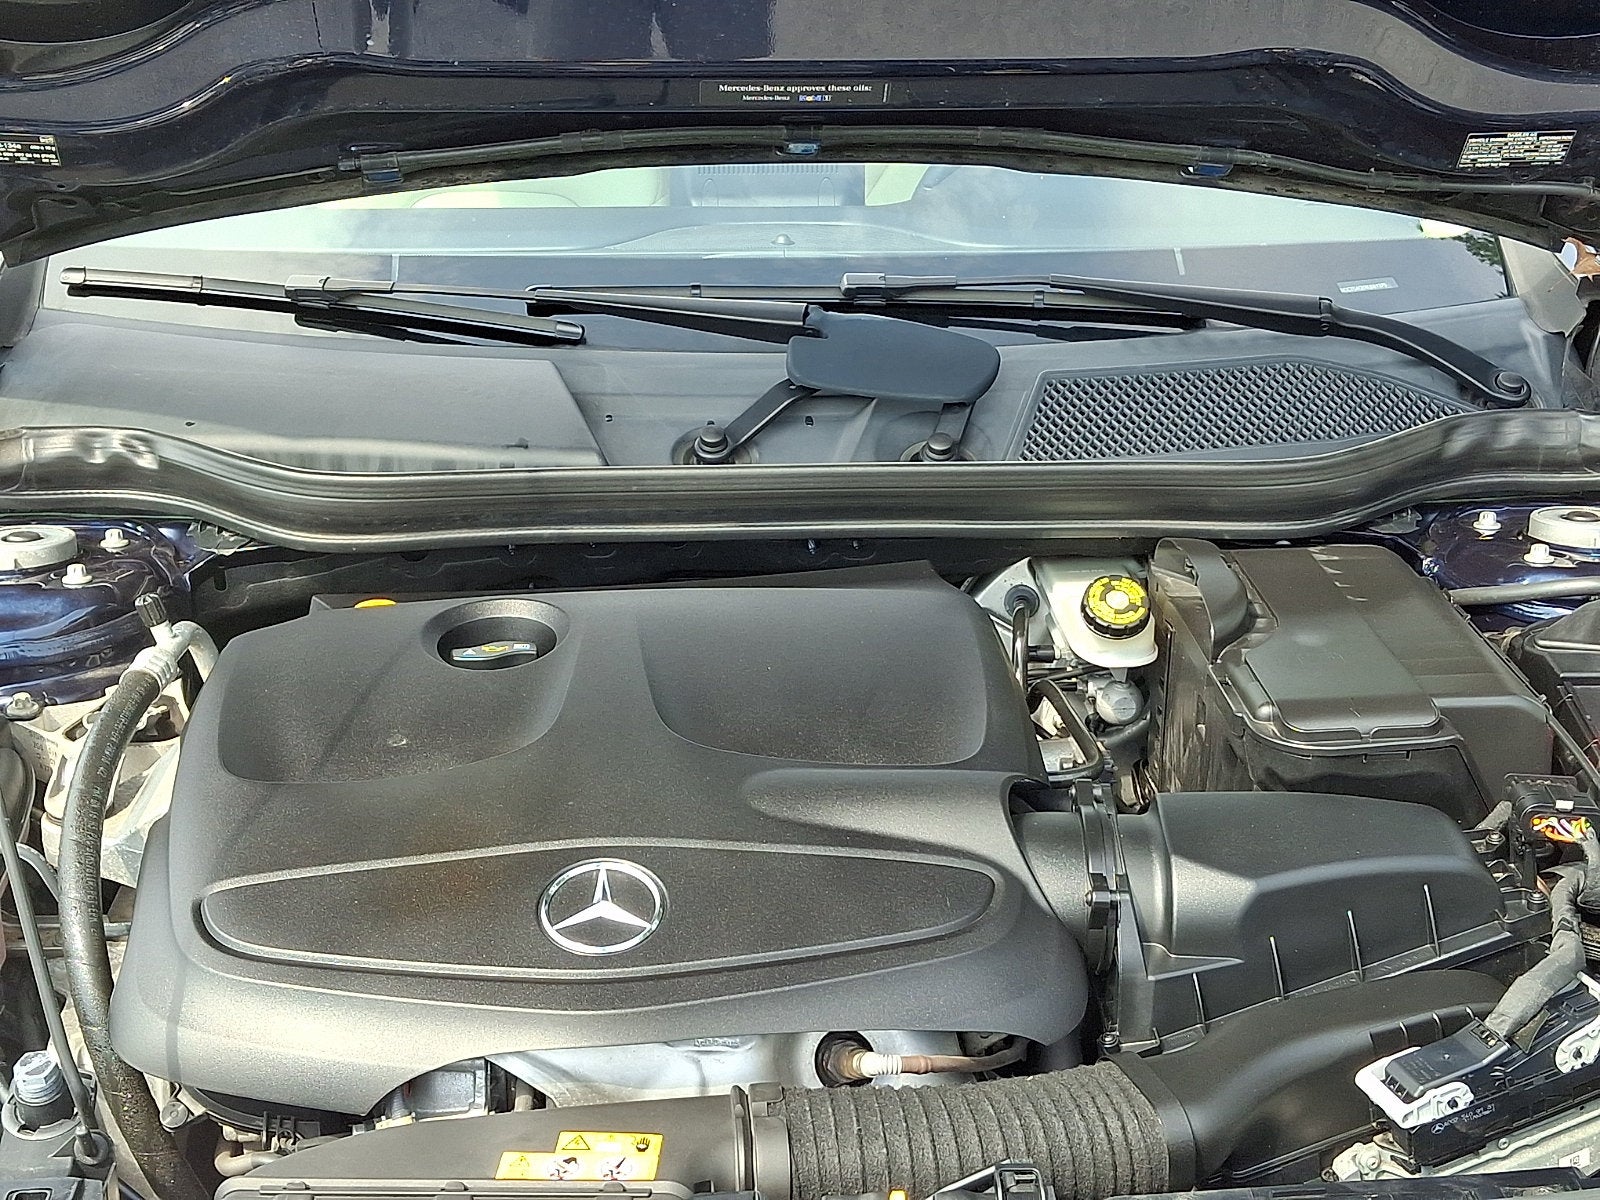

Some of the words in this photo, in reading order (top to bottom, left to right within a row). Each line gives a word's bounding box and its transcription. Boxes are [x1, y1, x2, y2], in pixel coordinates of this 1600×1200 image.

[718, 84, 785, 93] Mercedes-Benz
[786, 84, 826, 94] approves
[827, 84, 852, 93] these
[853, 84, 873, 93] oils:
[742, 94, 791, 102] Mercedes-Benz
